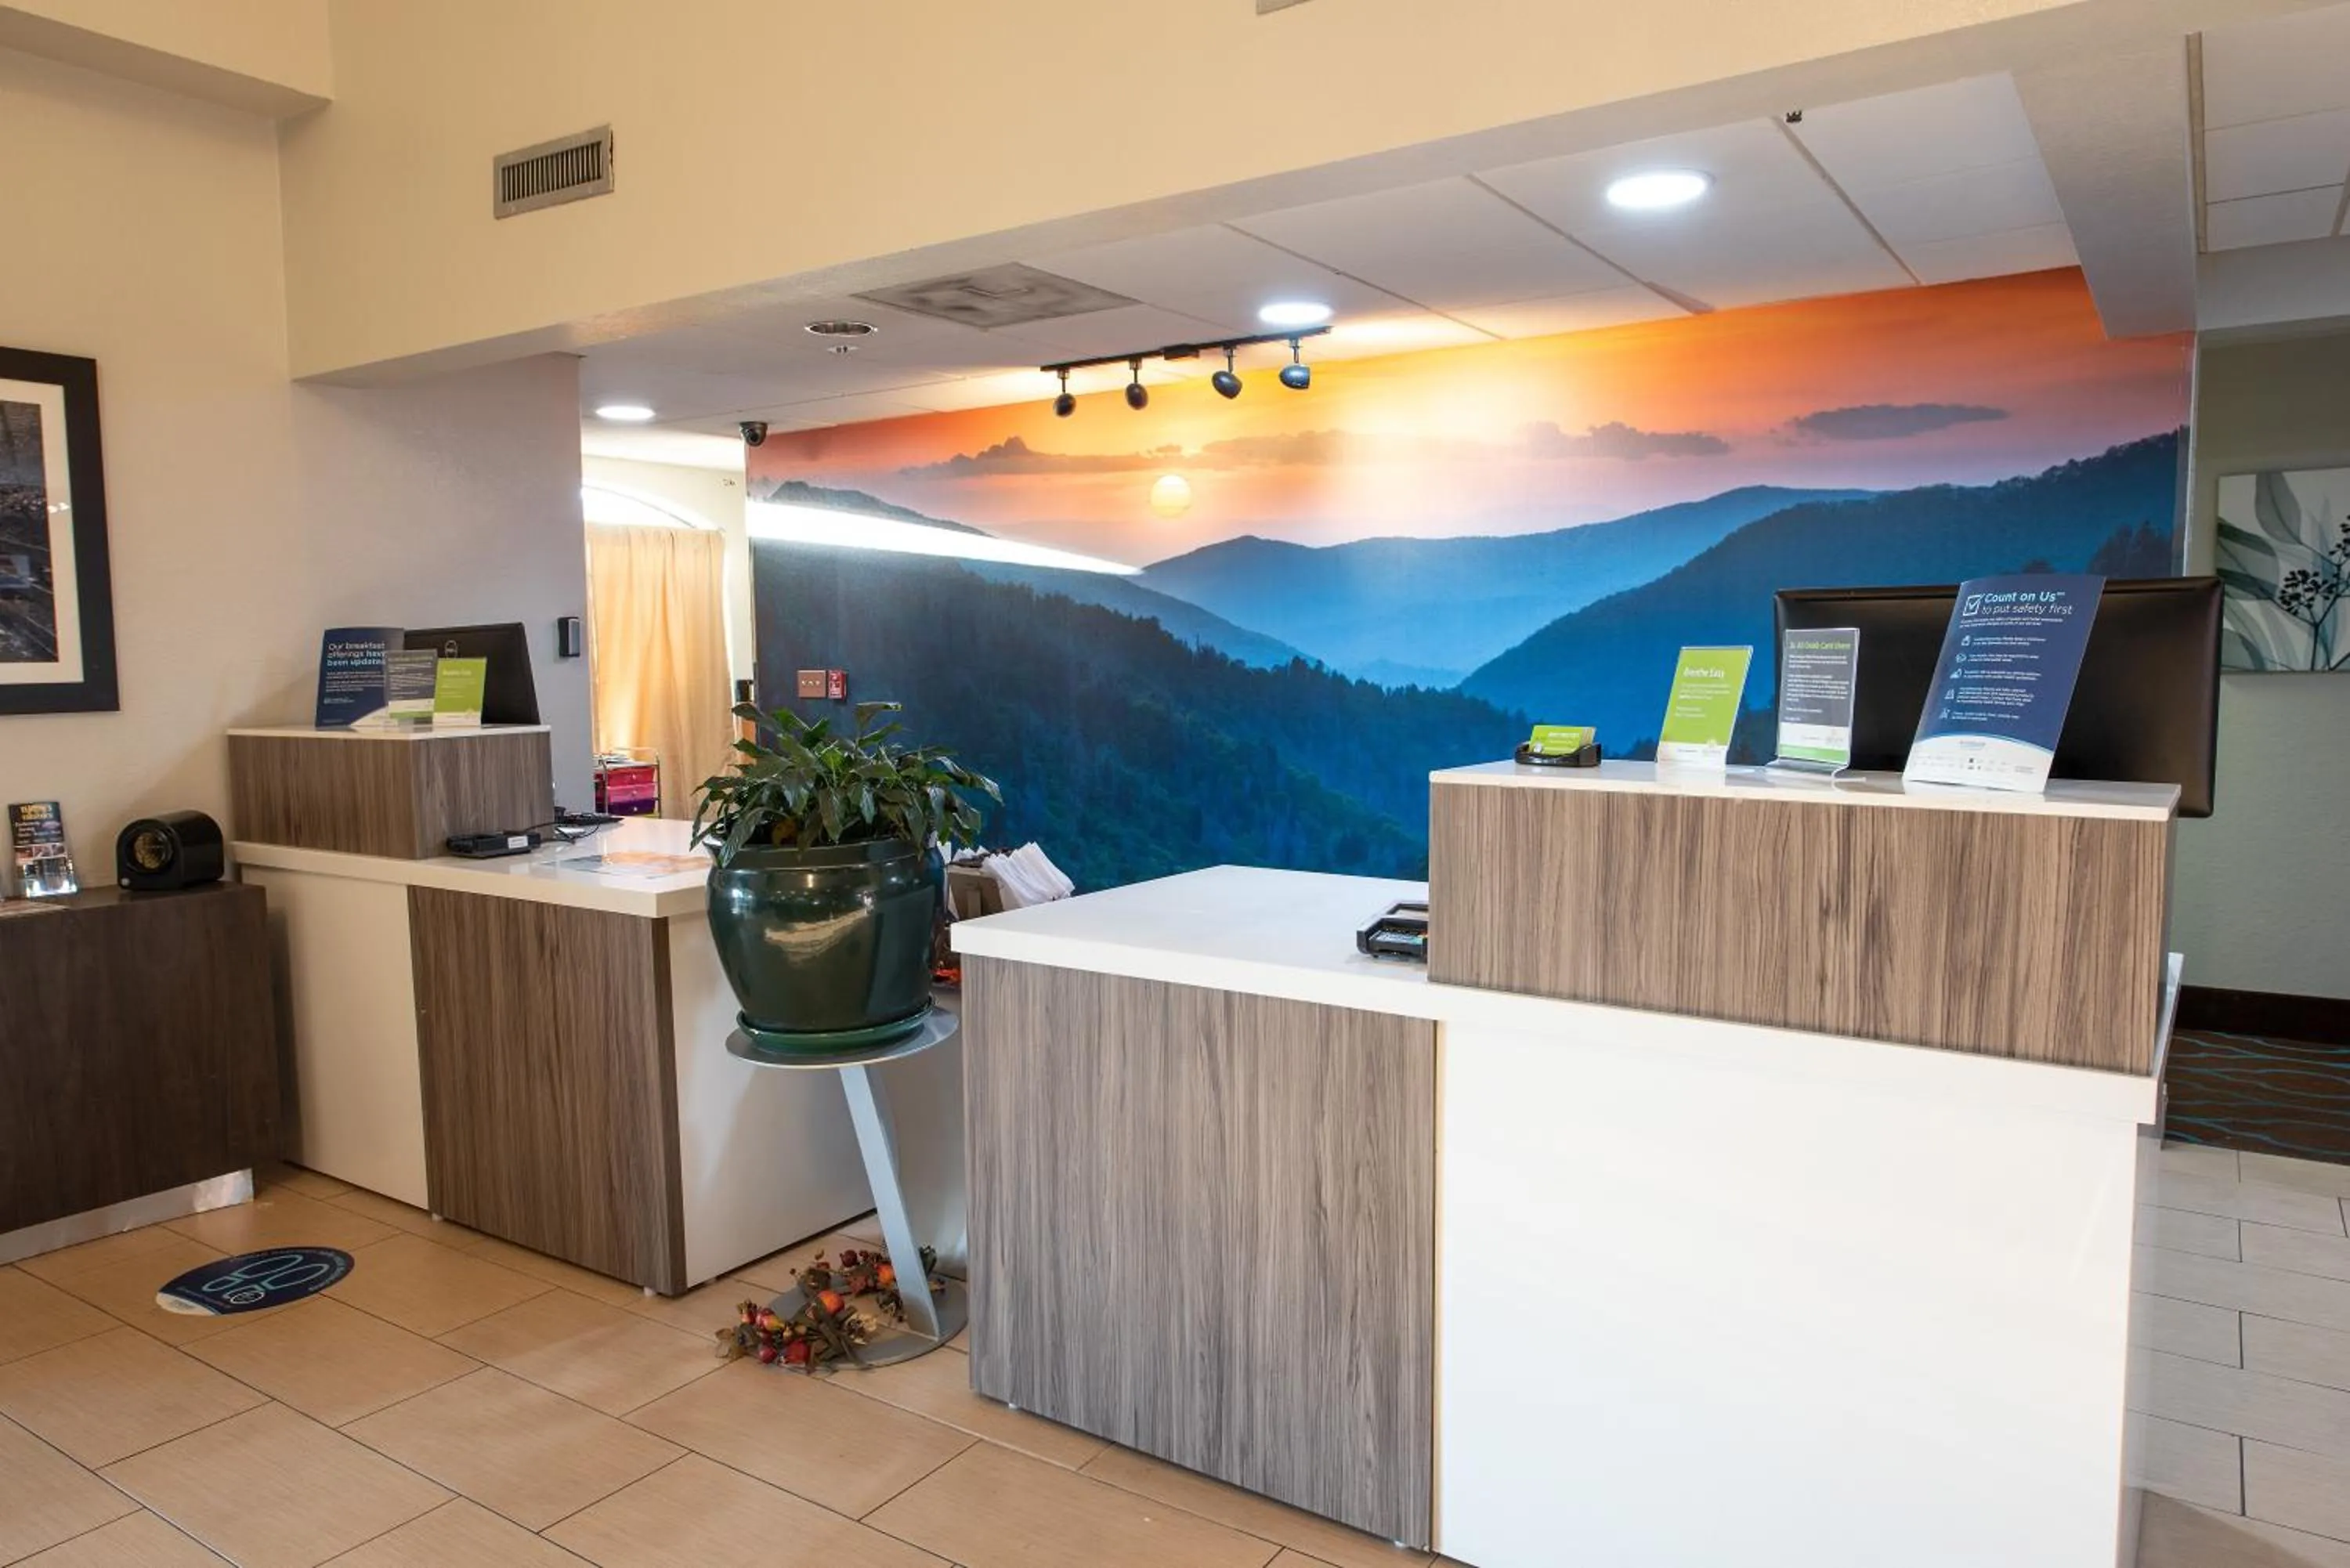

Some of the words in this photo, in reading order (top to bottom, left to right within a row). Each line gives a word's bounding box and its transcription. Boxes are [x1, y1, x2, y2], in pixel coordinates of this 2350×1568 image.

[1985, 592, 2016, 602] Count
[2020, 593, 2036, 602] on
[2040, 591, 2058, 602] Us
[1982, 606, 1991, 615] to
[1993, 605, 2010, 615] put
[2012, 603, 2047, 615] safety
[2048, 603, 2073, 616] first
[328, 642, 344, 652] Our
[345, 641, 385, 651] breakfast
[327, 659, 349, 667] been
